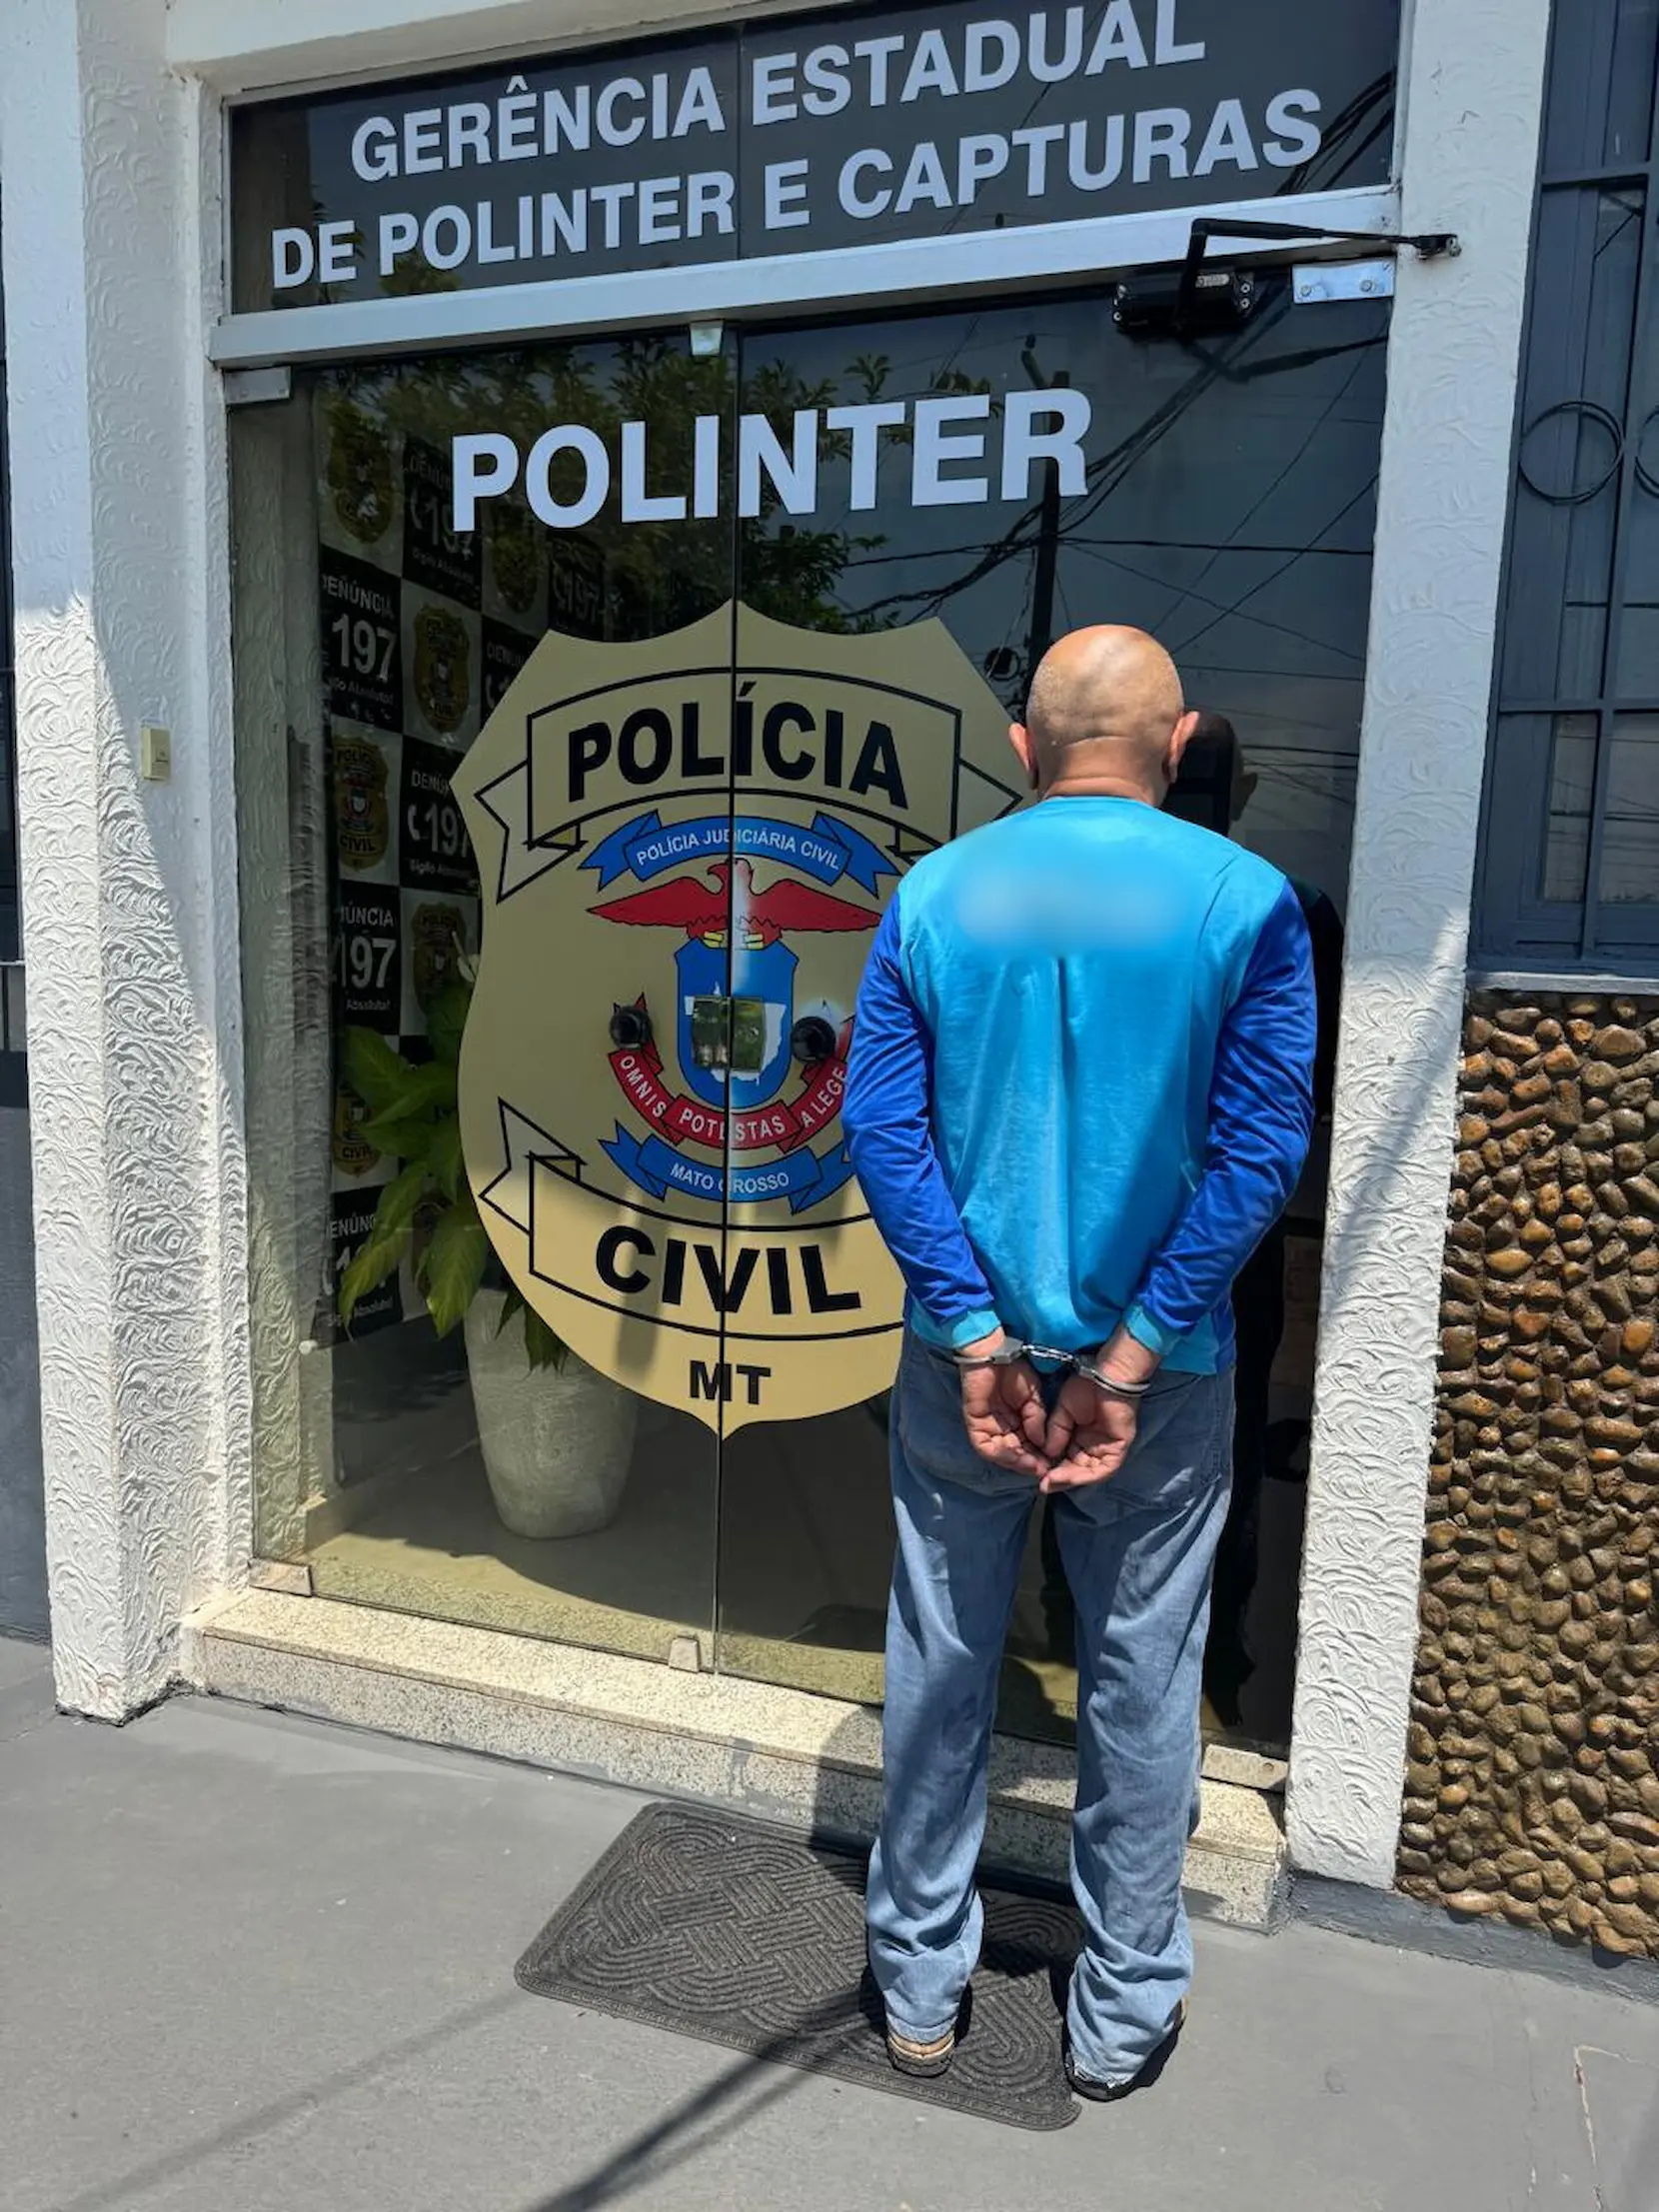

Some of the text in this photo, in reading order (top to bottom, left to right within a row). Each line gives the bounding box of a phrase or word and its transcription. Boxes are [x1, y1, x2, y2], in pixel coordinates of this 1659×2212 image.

[351, 0, 1206, 182] GERÊNCIA ESTADUAL
[272, 88, 1322, 289] DE POLINTER E CAPTURAS
[452, 388, 1093, 532] POLINTER
[332, 613, 397, 684] 197
[569, 682, 908, 810] POLÍCIA
[637, 833, 700, 867] POLÍCIA
[801, 841, 839, 871] CIVIL
[620, 1056, 667, 1117] OMNIS
[801, 1110, 816, 1127] A
[810, 1067, 847, 1115] LEGE
[670, 1162, 715, 1190] MATO
[596, 1225, 860, 1315] CIVIL
[689, 1359, 772, 1405] MT
